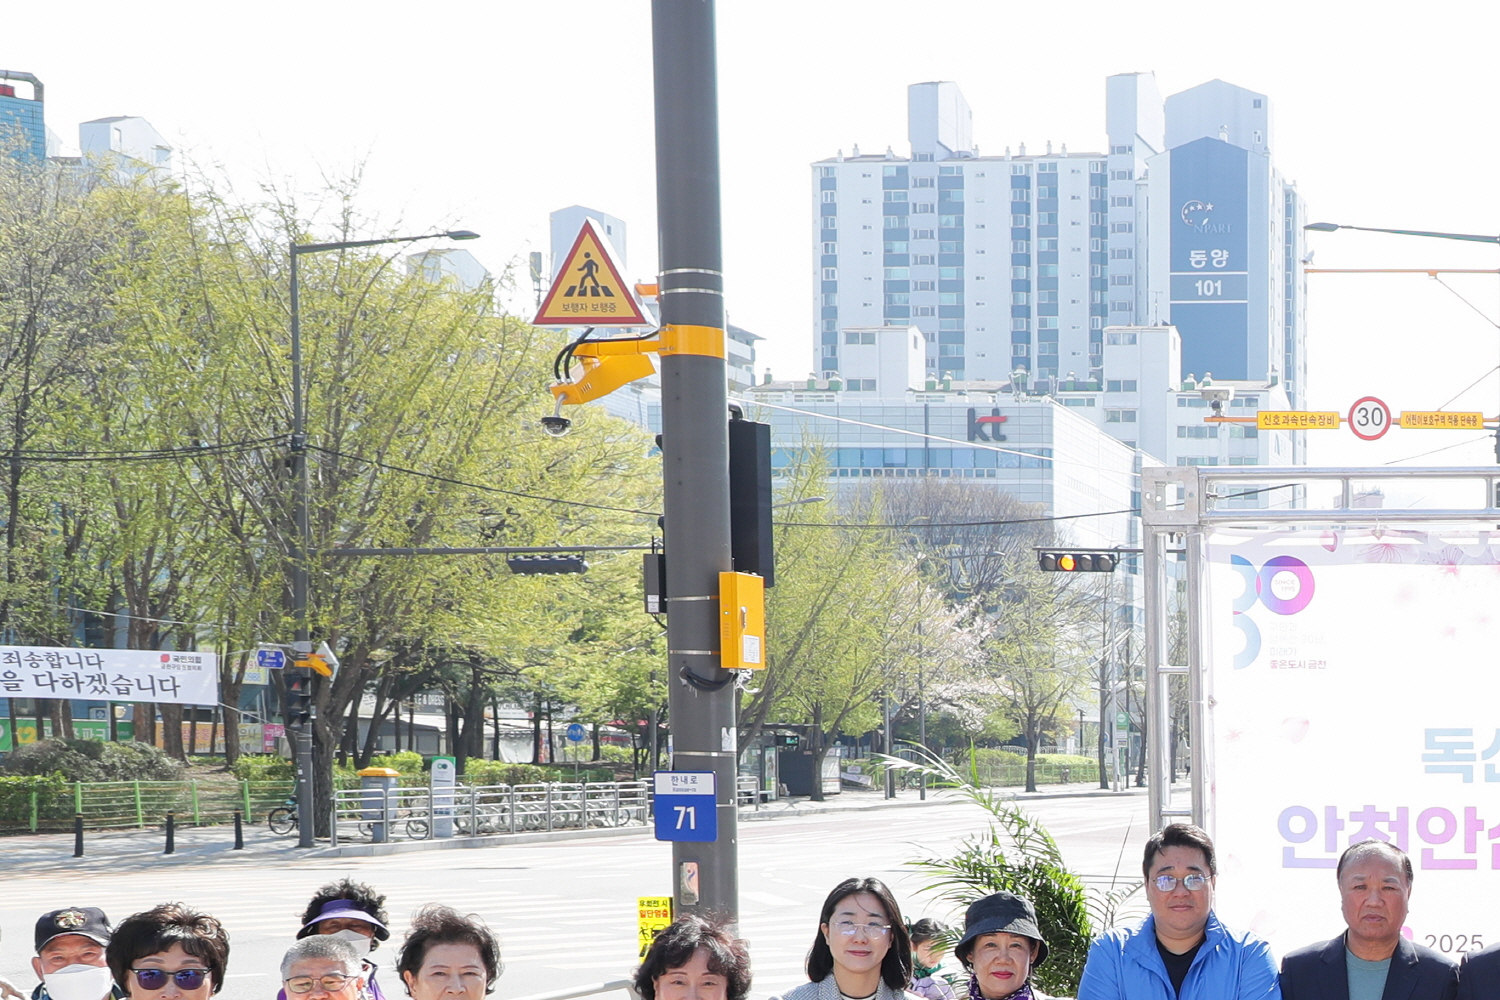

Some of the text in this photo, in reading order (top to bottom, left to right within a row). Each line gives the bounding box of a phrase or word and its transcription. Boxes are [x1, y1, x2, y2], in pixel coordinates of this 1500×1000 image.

[1189, 249, 1229, 268] 동양
[1195, 280, 1222, 296] 101
[562, 302, 617, 313] 보행자 보행중
[967, 408, 1007, 441] kt
[1357, 407, 1383, 427] 30
[2, 650, 105, 670] 죄송합니다
[172, 655, 202, 663] 국민의힘
[1308, 659, 1327, 669] 금천
[32, 670, 181, 698] 다하겠습니다
[671, 775, 698, 786] 한내로
[673, 806, 696, 830] 71
[639, 899, 668, 907] 우회전 시
